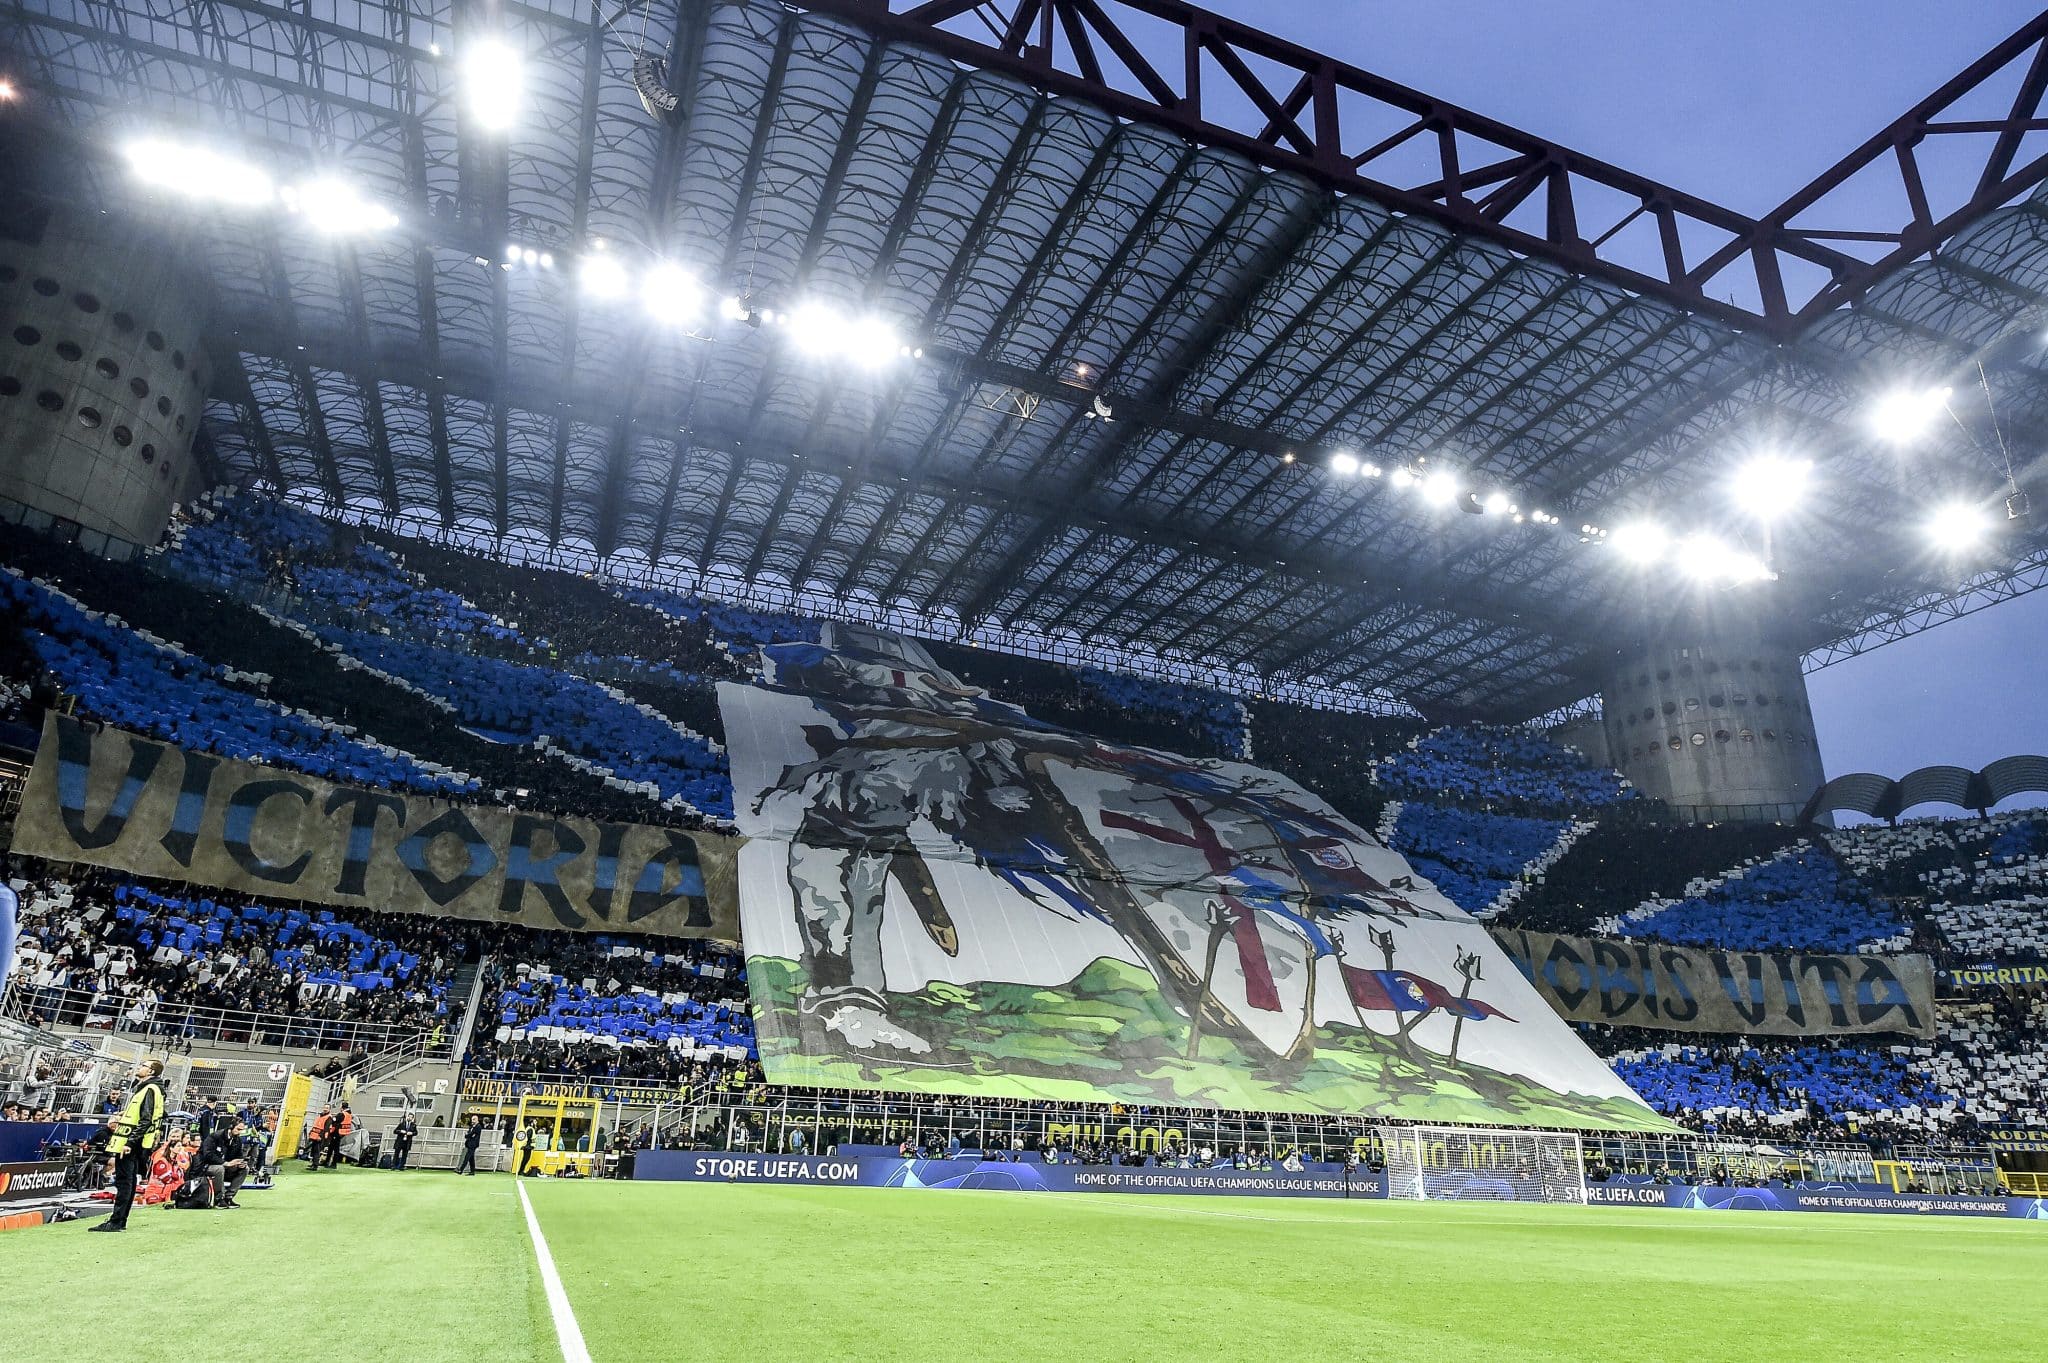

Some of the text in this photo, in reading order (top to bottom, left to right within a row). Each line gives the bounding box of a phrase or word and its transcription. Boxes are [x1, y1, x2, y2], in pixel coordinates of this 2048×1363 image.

[56, 713, 713, 929] VICTORIA
[1950, 966, 2048, 985] TORRITA
[1710, 953, 1923, 1029] VITA
[462, 1079, 589, 1107] RIVIERA BERICA
[771, 1114, 913, 1131] ROCCASPINALVETI
[9, 1166, 68, 1191] mastercard
[695, 1158, 858, 1180] STORE.UEFA.COM
[1074, 1173, 1379, 1193] HOME OF THE OFFICIAL UEFA CHAMPIONS LEAGUE MERCHANDISE
[1798, 1196, 2008, 1212] HOME OF THE OFFICIAL UEFA CHAMPIONS LEAGUE MERCHANDISE
